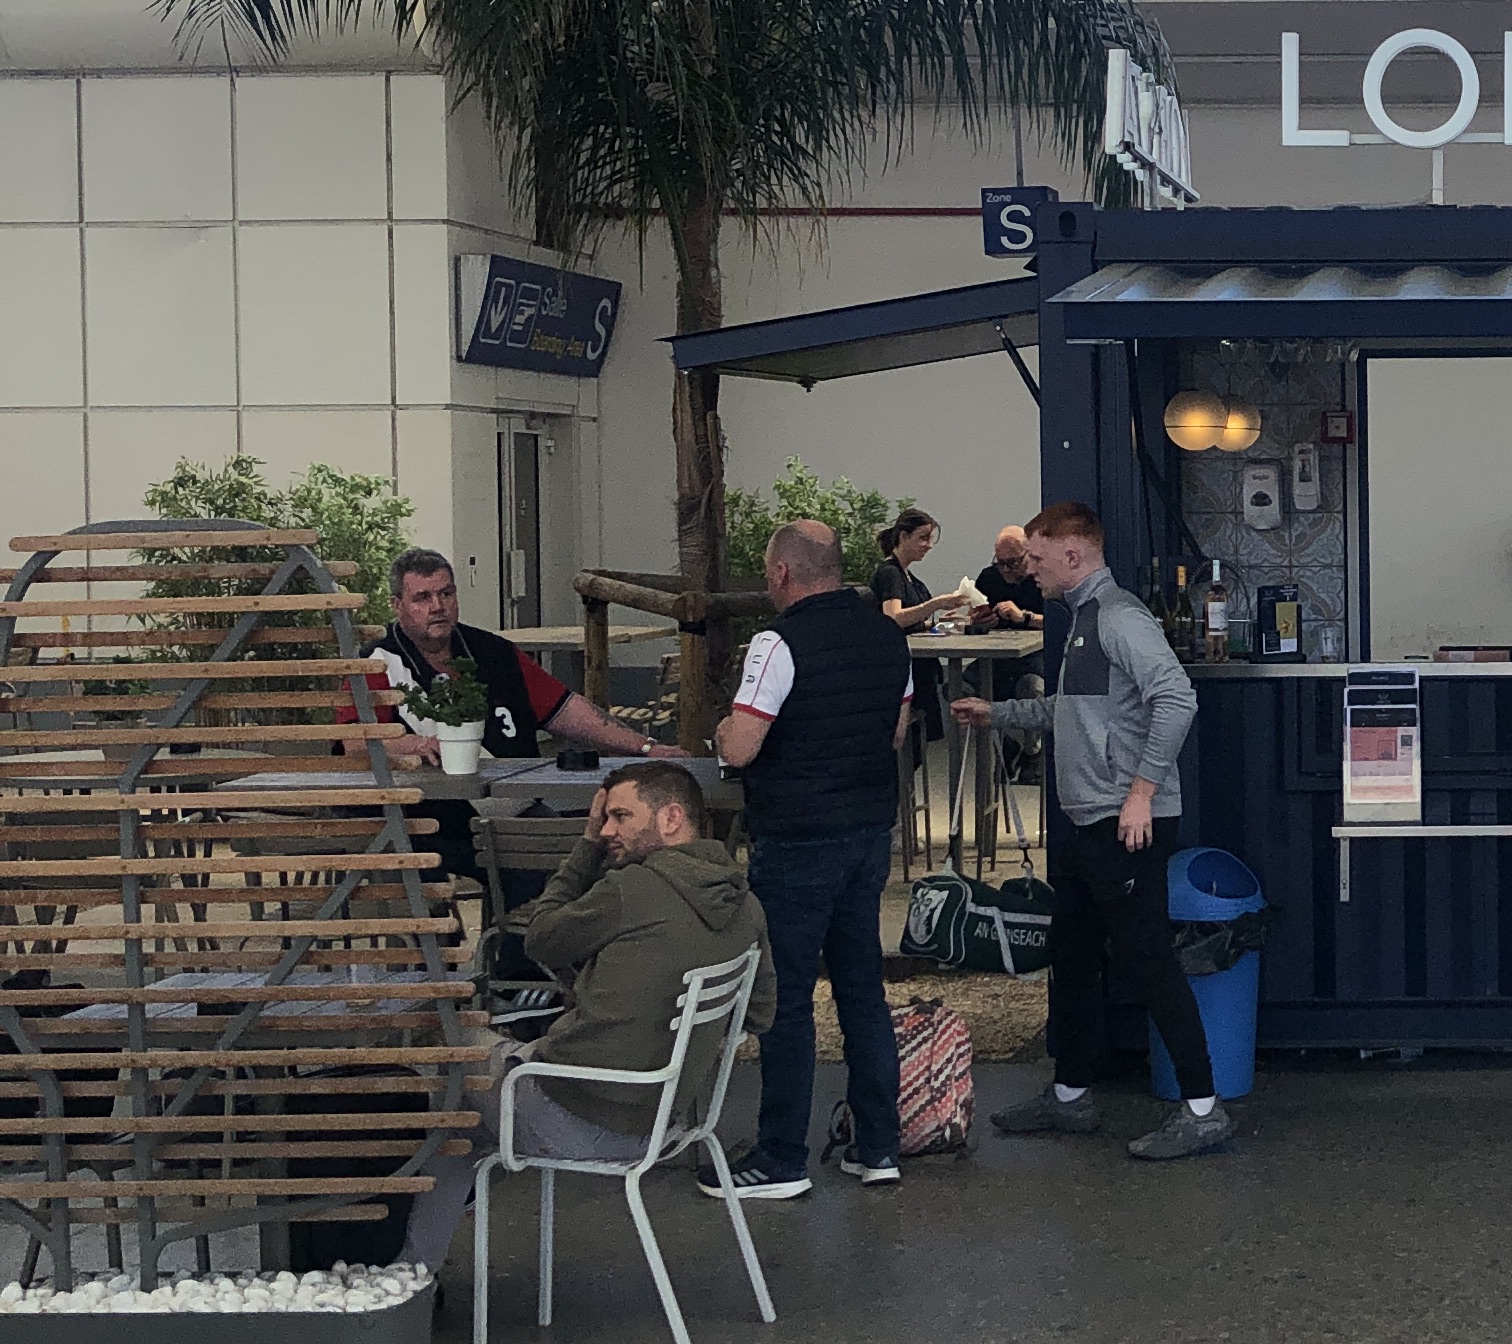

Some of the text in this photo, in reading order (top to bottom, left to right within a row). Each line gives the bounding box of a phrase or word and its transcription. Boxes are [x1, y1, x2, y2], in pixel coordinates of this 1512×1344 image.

[985, 192, 1012, 203] Zone
[1000, 204, 1034, 251] S
[541, 287, 567, 318] Sae
[586, 297, 612, 361] S
[495, 706, 517, 738] 3
[973, 921, 990, 939] AN
